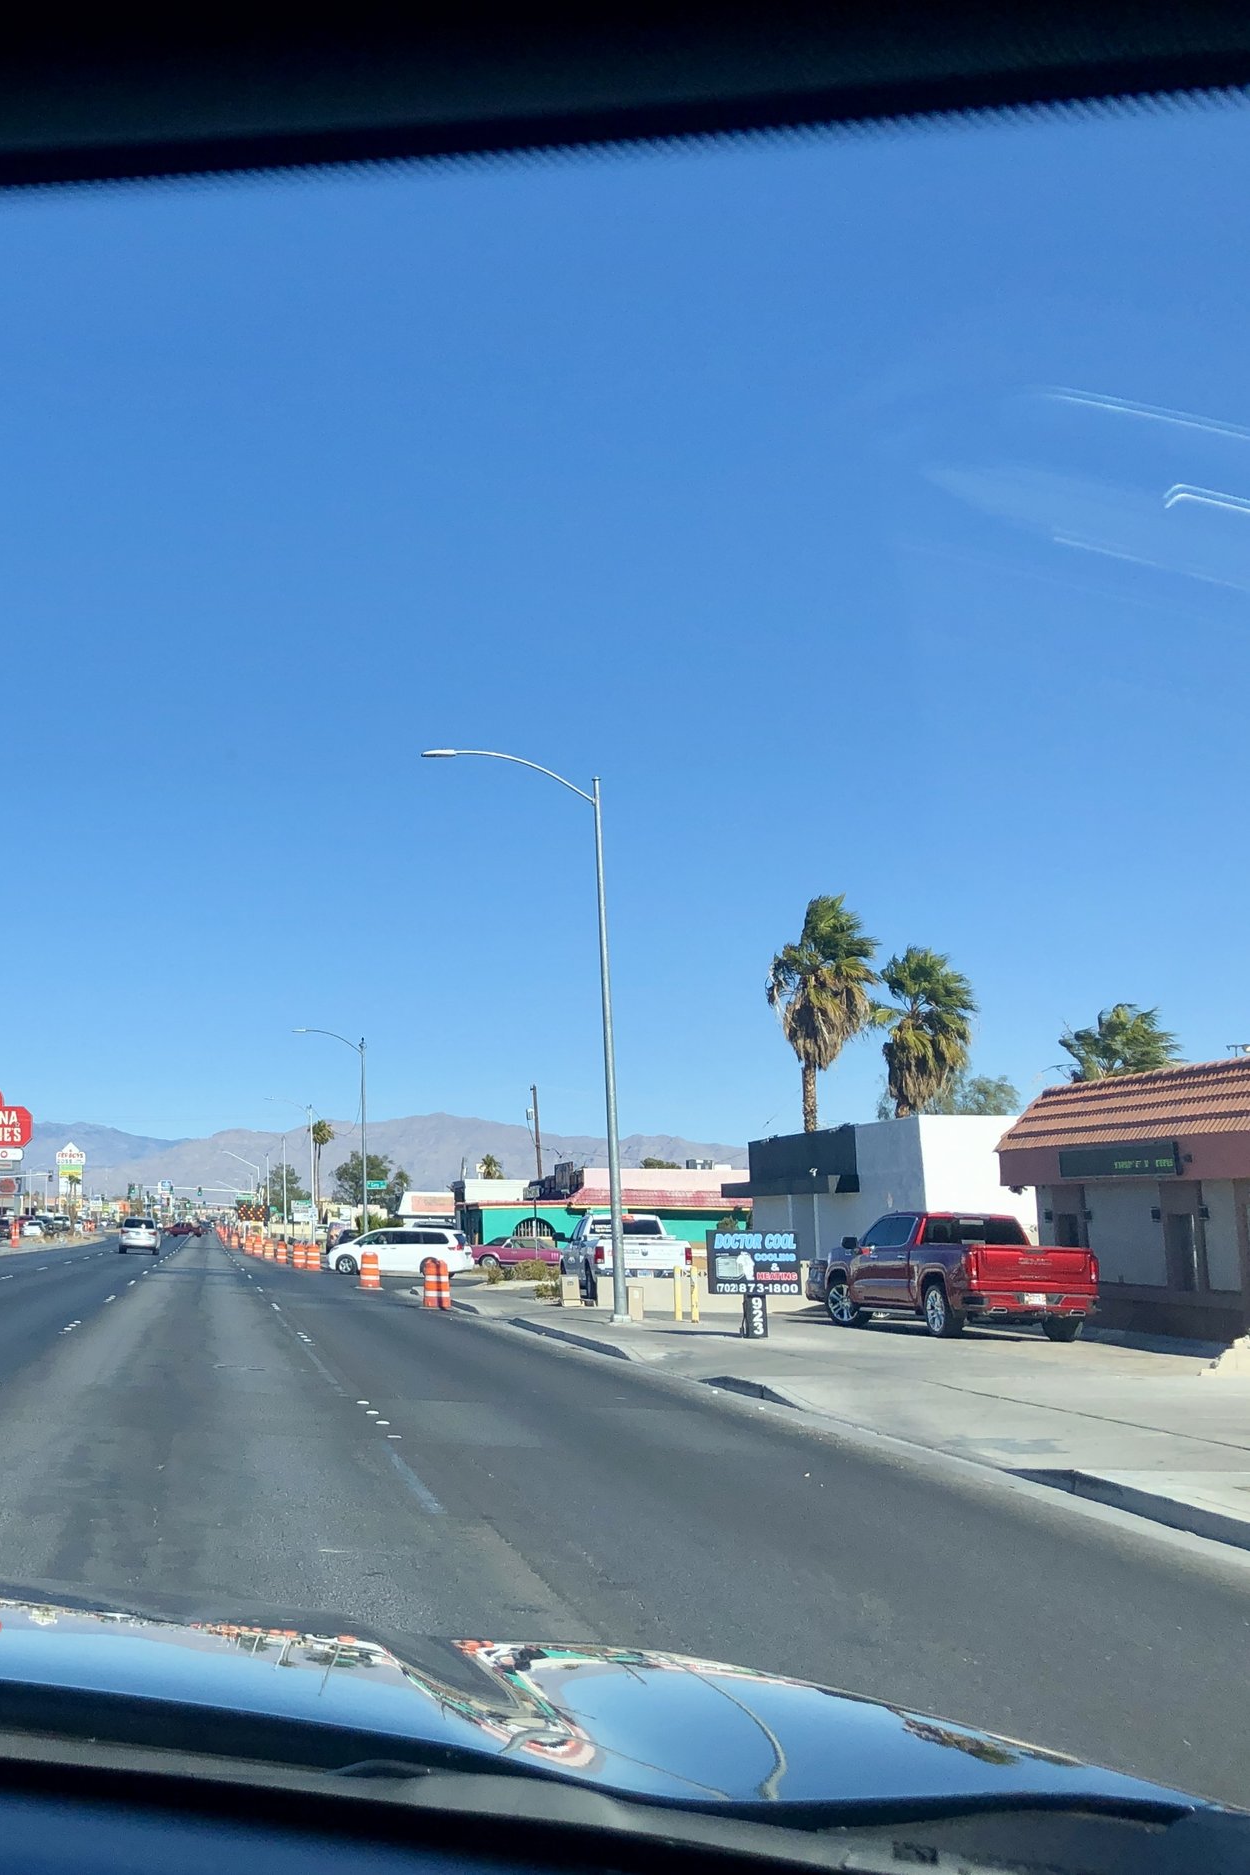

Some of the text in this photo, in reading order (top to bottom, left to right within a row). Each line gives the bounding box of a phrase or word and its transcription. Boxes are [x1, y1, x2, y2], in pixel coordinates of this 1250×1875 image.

[714, 1233, 797, 1249] DOCTOR COOL
[754, 1253, 797, 1262] COOLING
[771, 1263, 780, 1271] &
[756, 1272, 798, 1280] HEATING
[751, 1297, 764, 1335] 923
